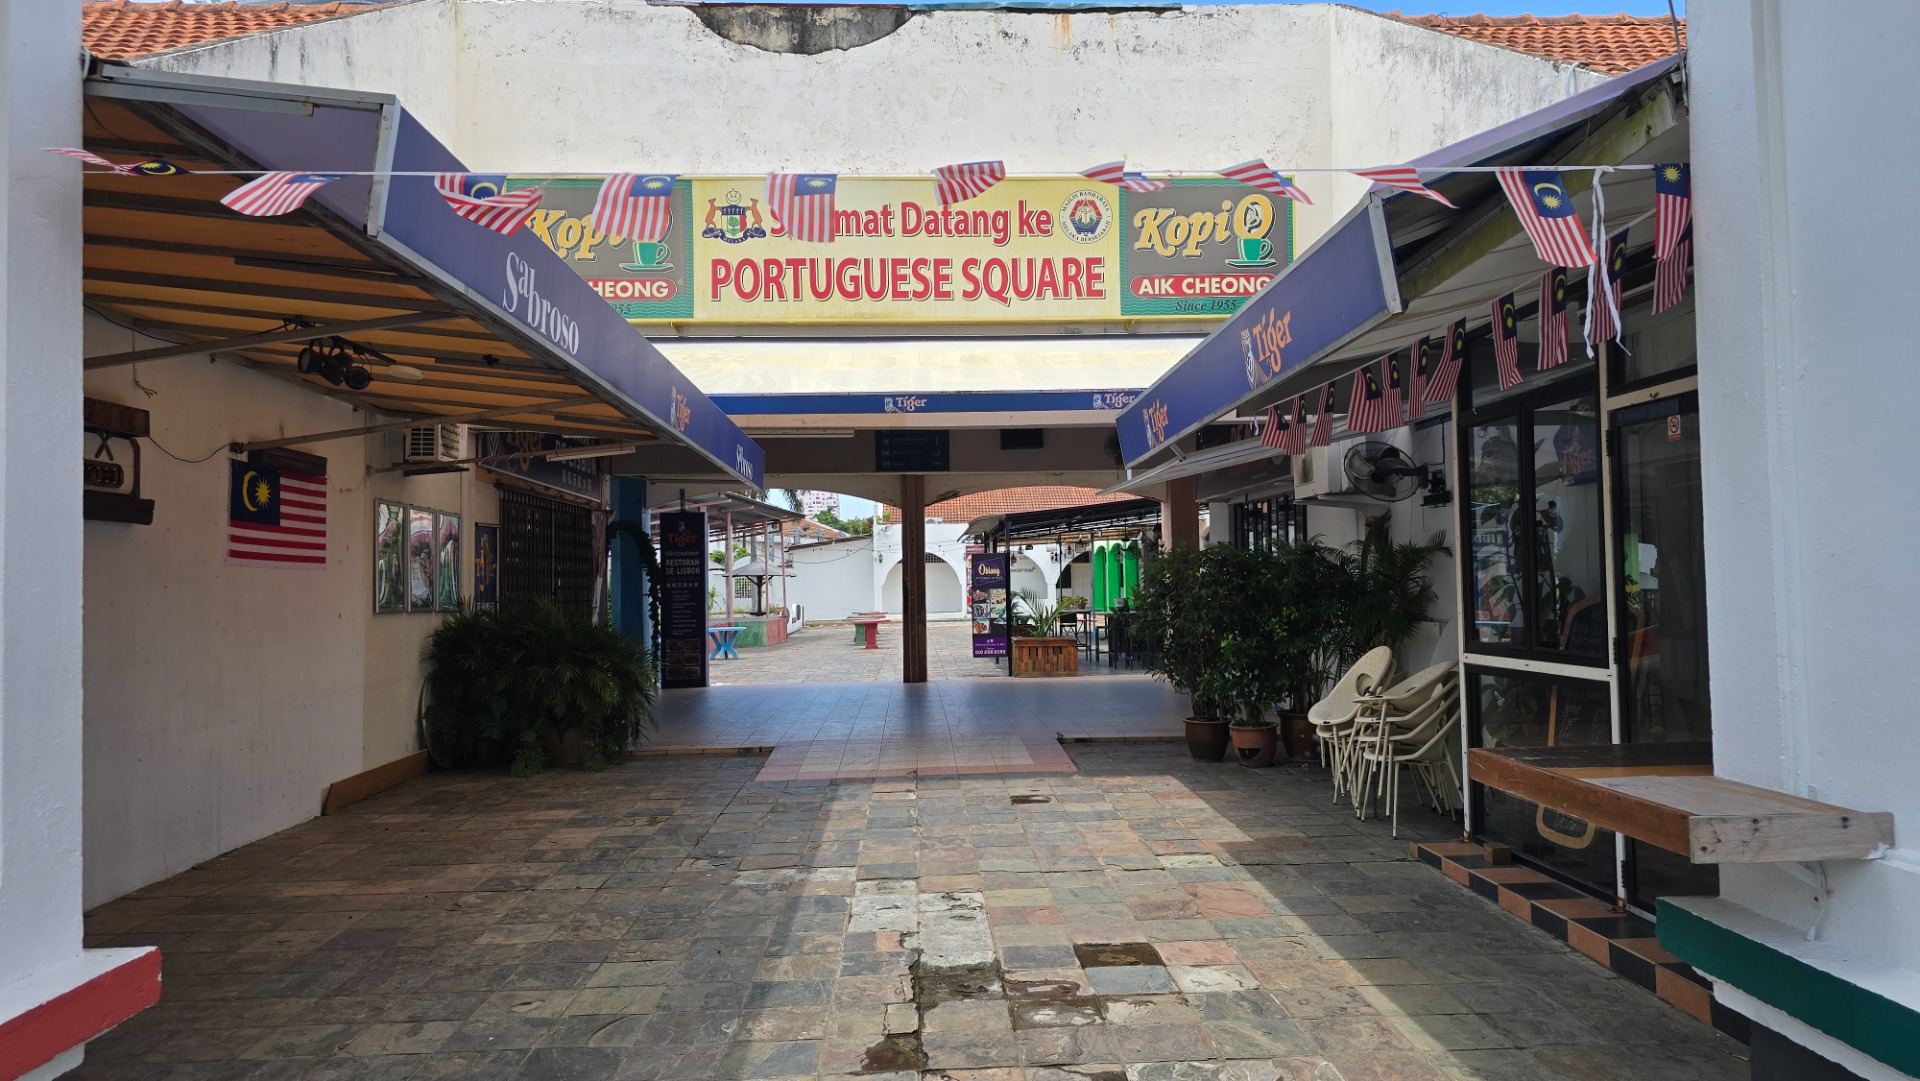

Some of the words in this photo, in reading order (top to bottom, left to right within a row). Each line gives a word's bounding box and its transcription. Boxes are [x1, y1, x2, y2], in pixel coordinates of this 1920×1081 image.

[901, 204, 1010, 245] Datang
[1018, 200, 1053, 237] ke
[588, 281, 669, 298] HEONG
[711, 257, 953, 302] PORTUGUESE
[962, 256, 1106, 306] SQUARE
[1138, 278, 1175, 295] AIK
[503, 252, 579, 355] Sabroso
[1175, 300, 1206, 311] Since
[1211, 300, 1237, 311] 1955
[1252, 306, 1293, 373] Tiger
[895, 396, 927, 411] Tiger
[1104, 392, 1135, 408] Tiger
[677, 393, 691, 432] Tiger
[1148, 397, 1170, 442] Tiger
[665, 558, 700, 567] RESTORAN
[677, 566, 700, 576] LISBON
